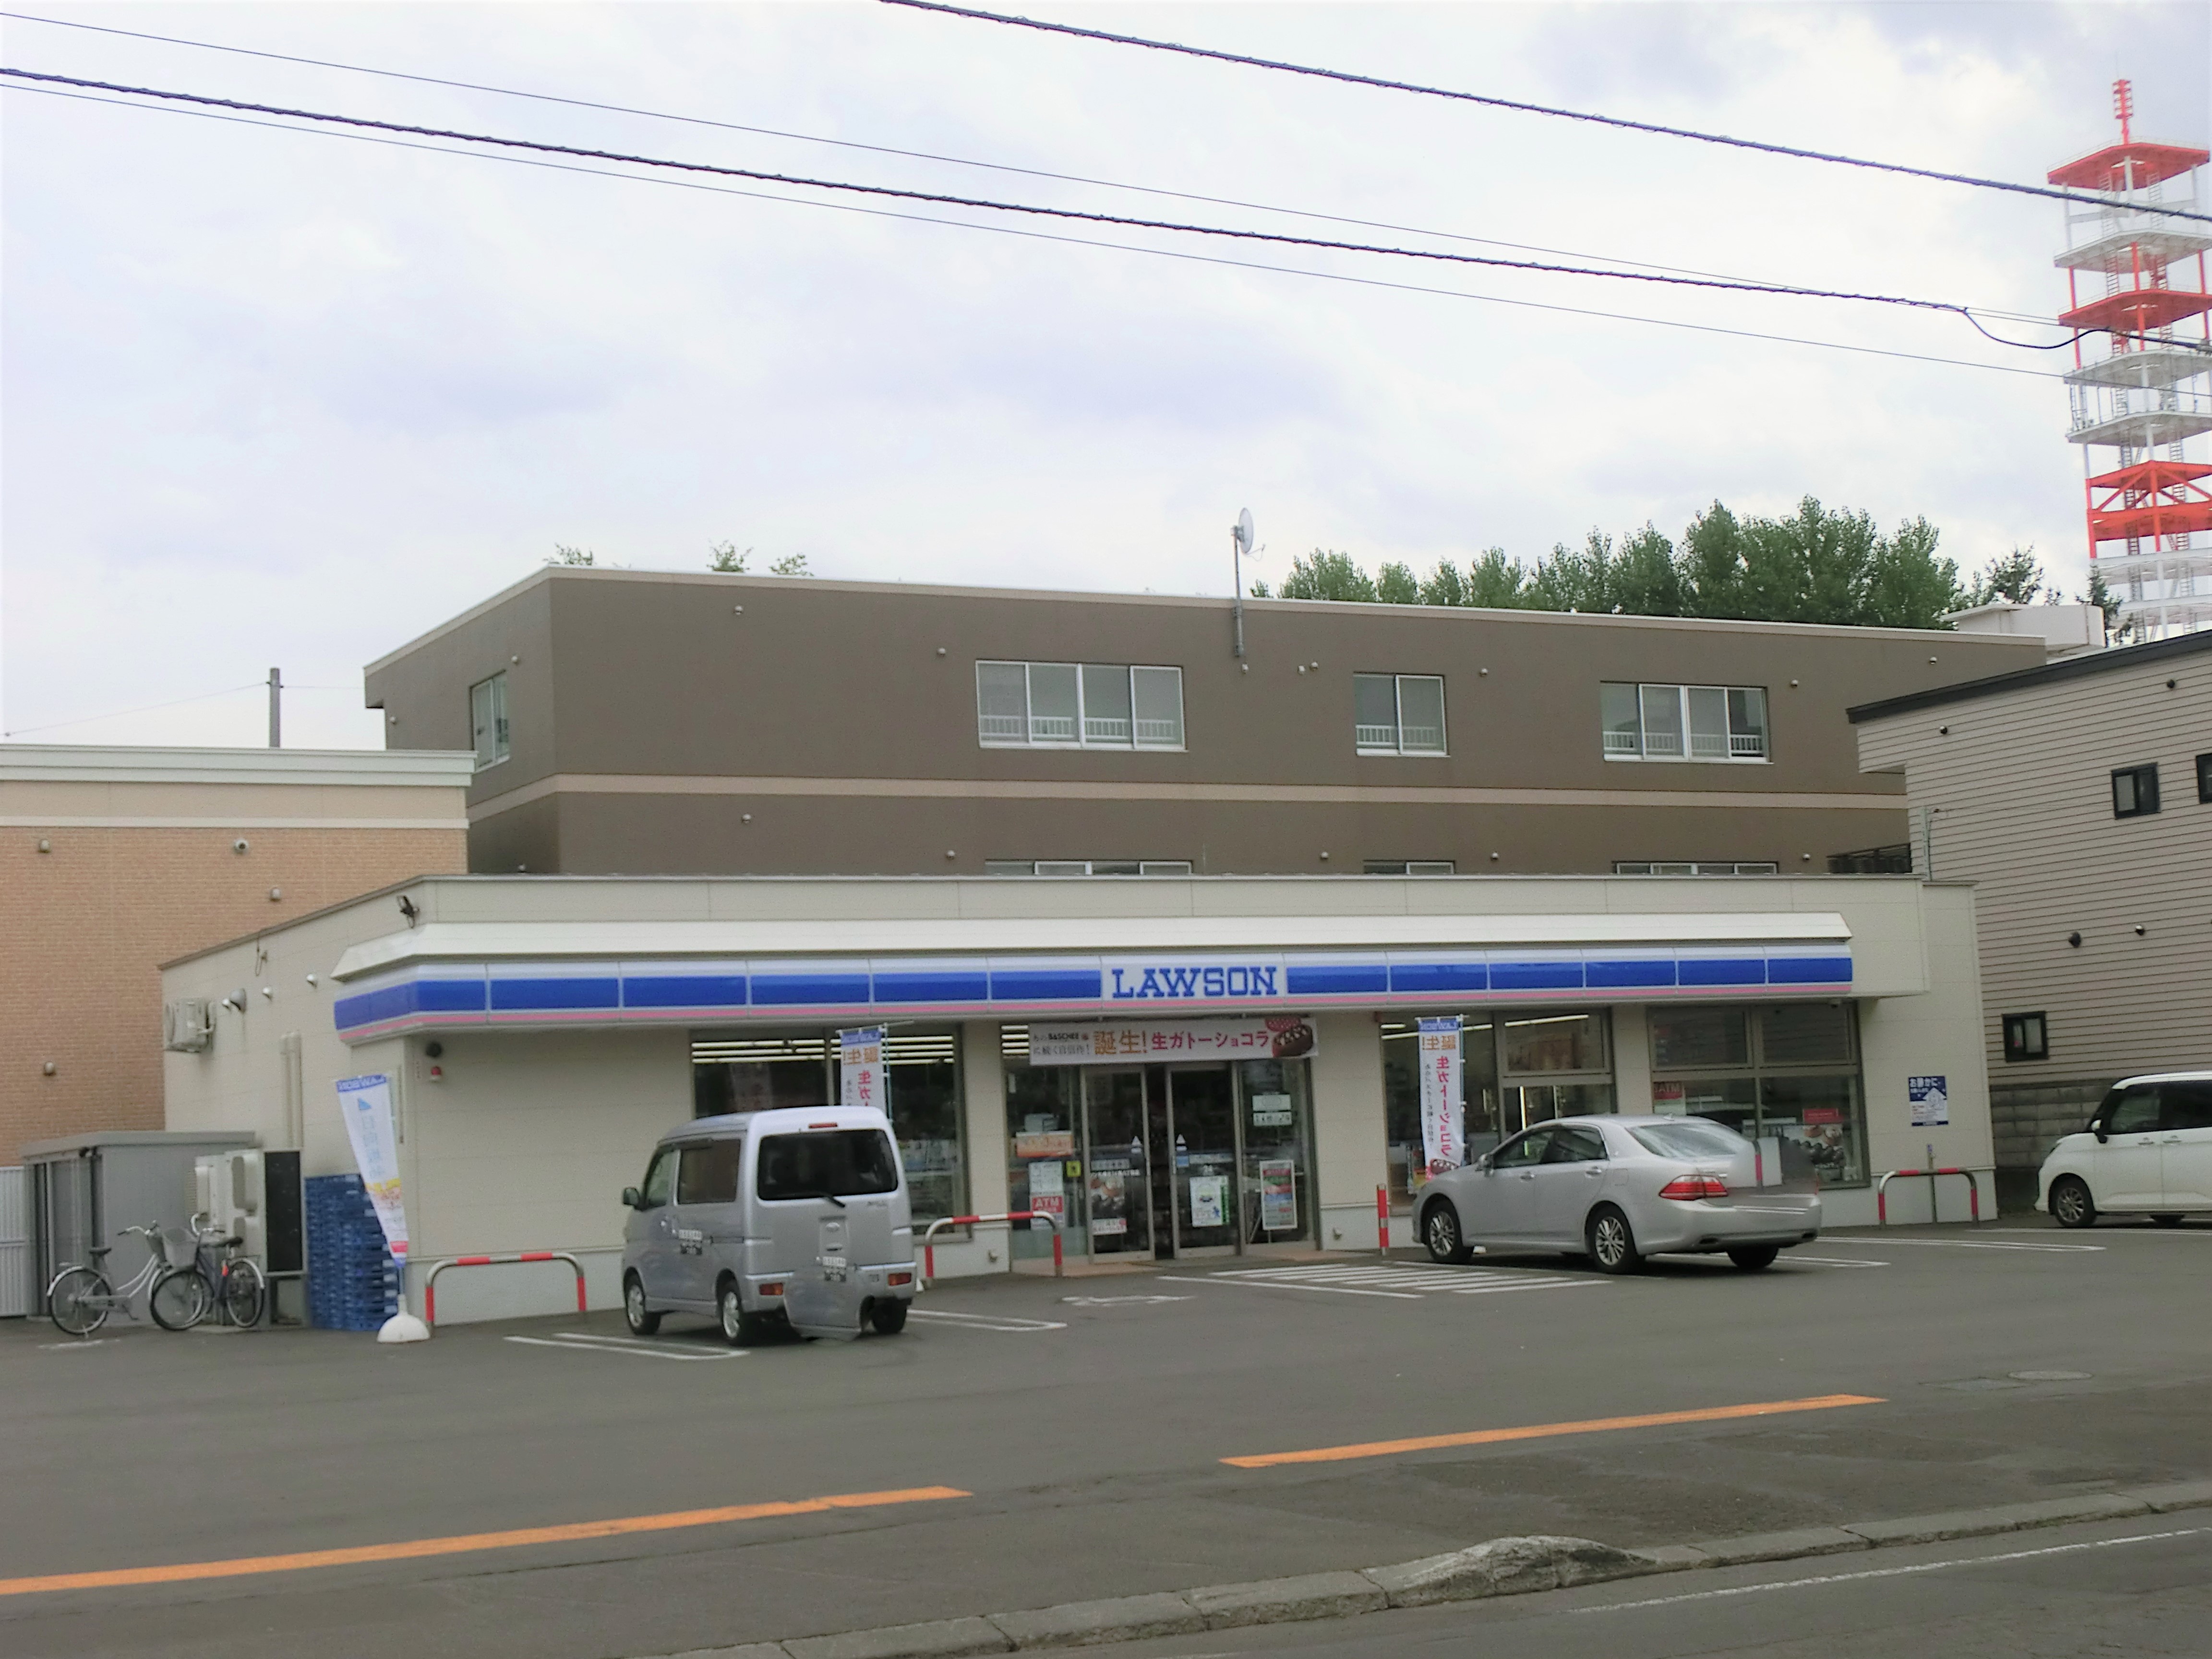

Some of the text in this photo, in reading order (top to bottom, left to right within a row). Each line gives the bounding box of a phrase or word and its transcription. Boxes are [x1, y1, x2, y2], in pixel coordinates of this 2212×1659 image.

[1112, 966, 1277, 998] LAWSON
[1152, 1031, 1269, 1050] 生ガトーショコラ
[1035, 1197, 1059, 1207] ATM
